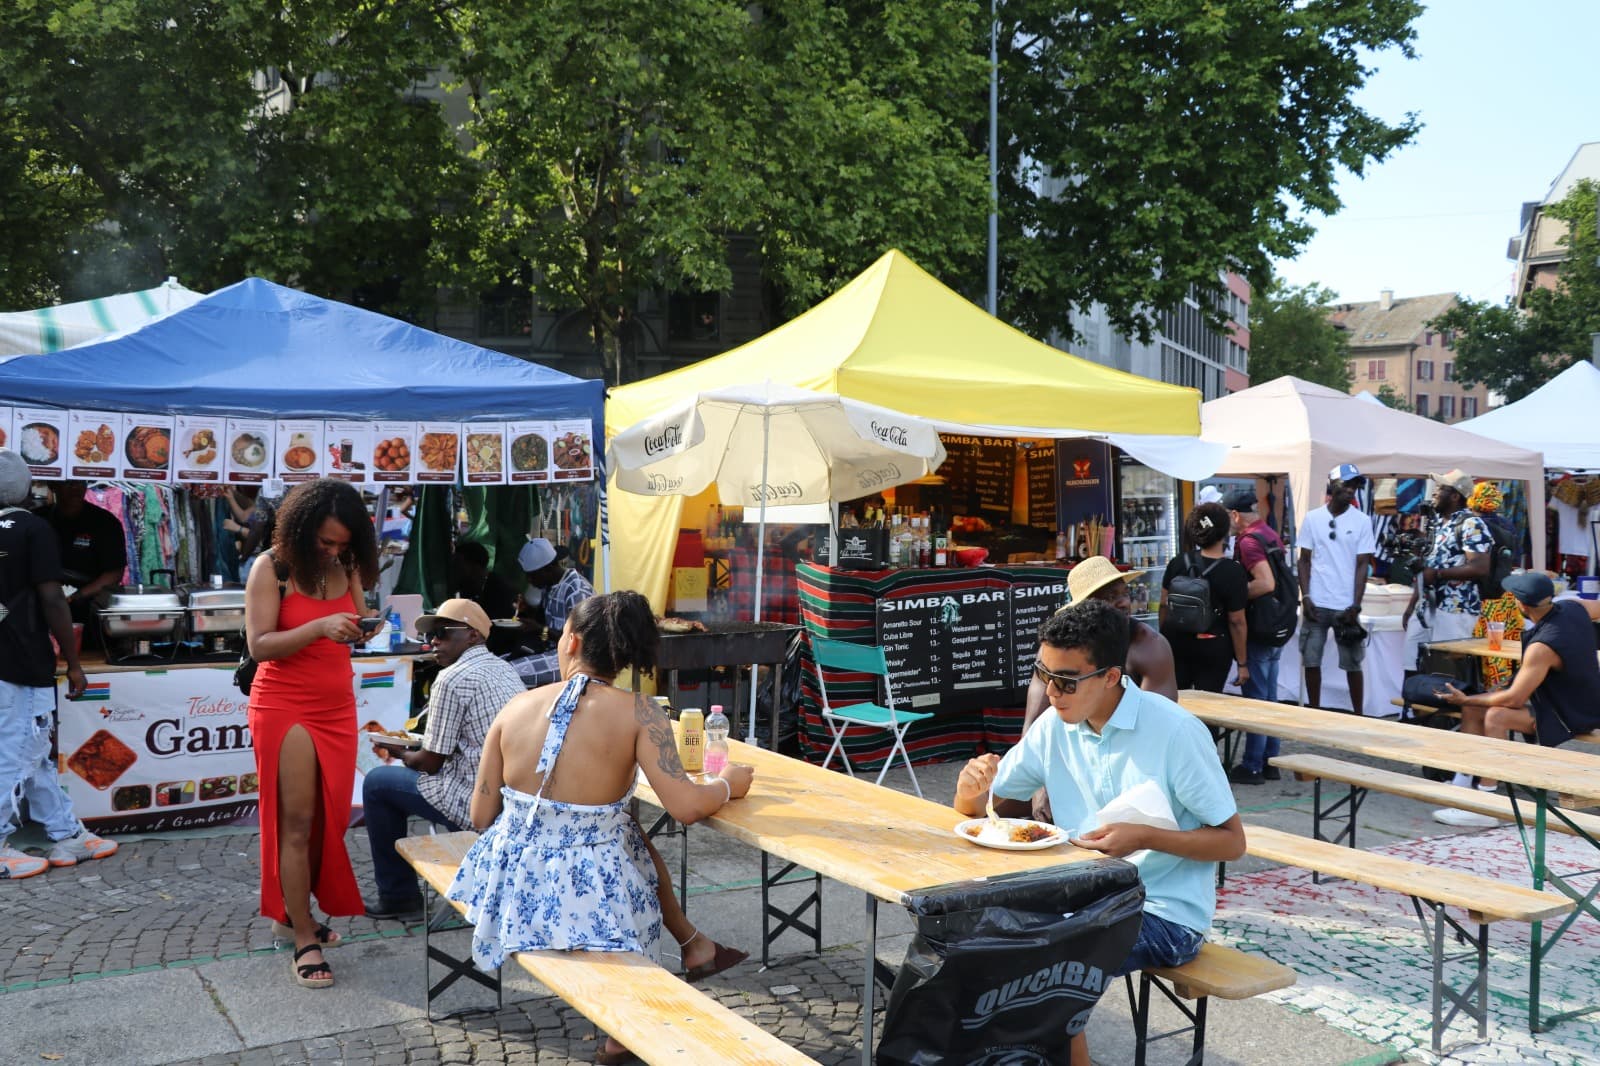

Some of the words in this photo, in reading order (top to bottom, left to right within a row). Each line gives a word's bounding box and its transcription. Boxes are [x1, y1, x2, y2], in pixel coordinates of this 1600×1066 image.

[940, 435, 980, 445] SIMBA
[983, 438, 1013, 447] BAR
[1030, 448, 1055, 459] SIM
[882, 596, 959, 612] SIMBA
[962, 591, 1005, 604] BAR
[187, 695, 233, 715] Taste
[145, 718, 254, 756] Gam
